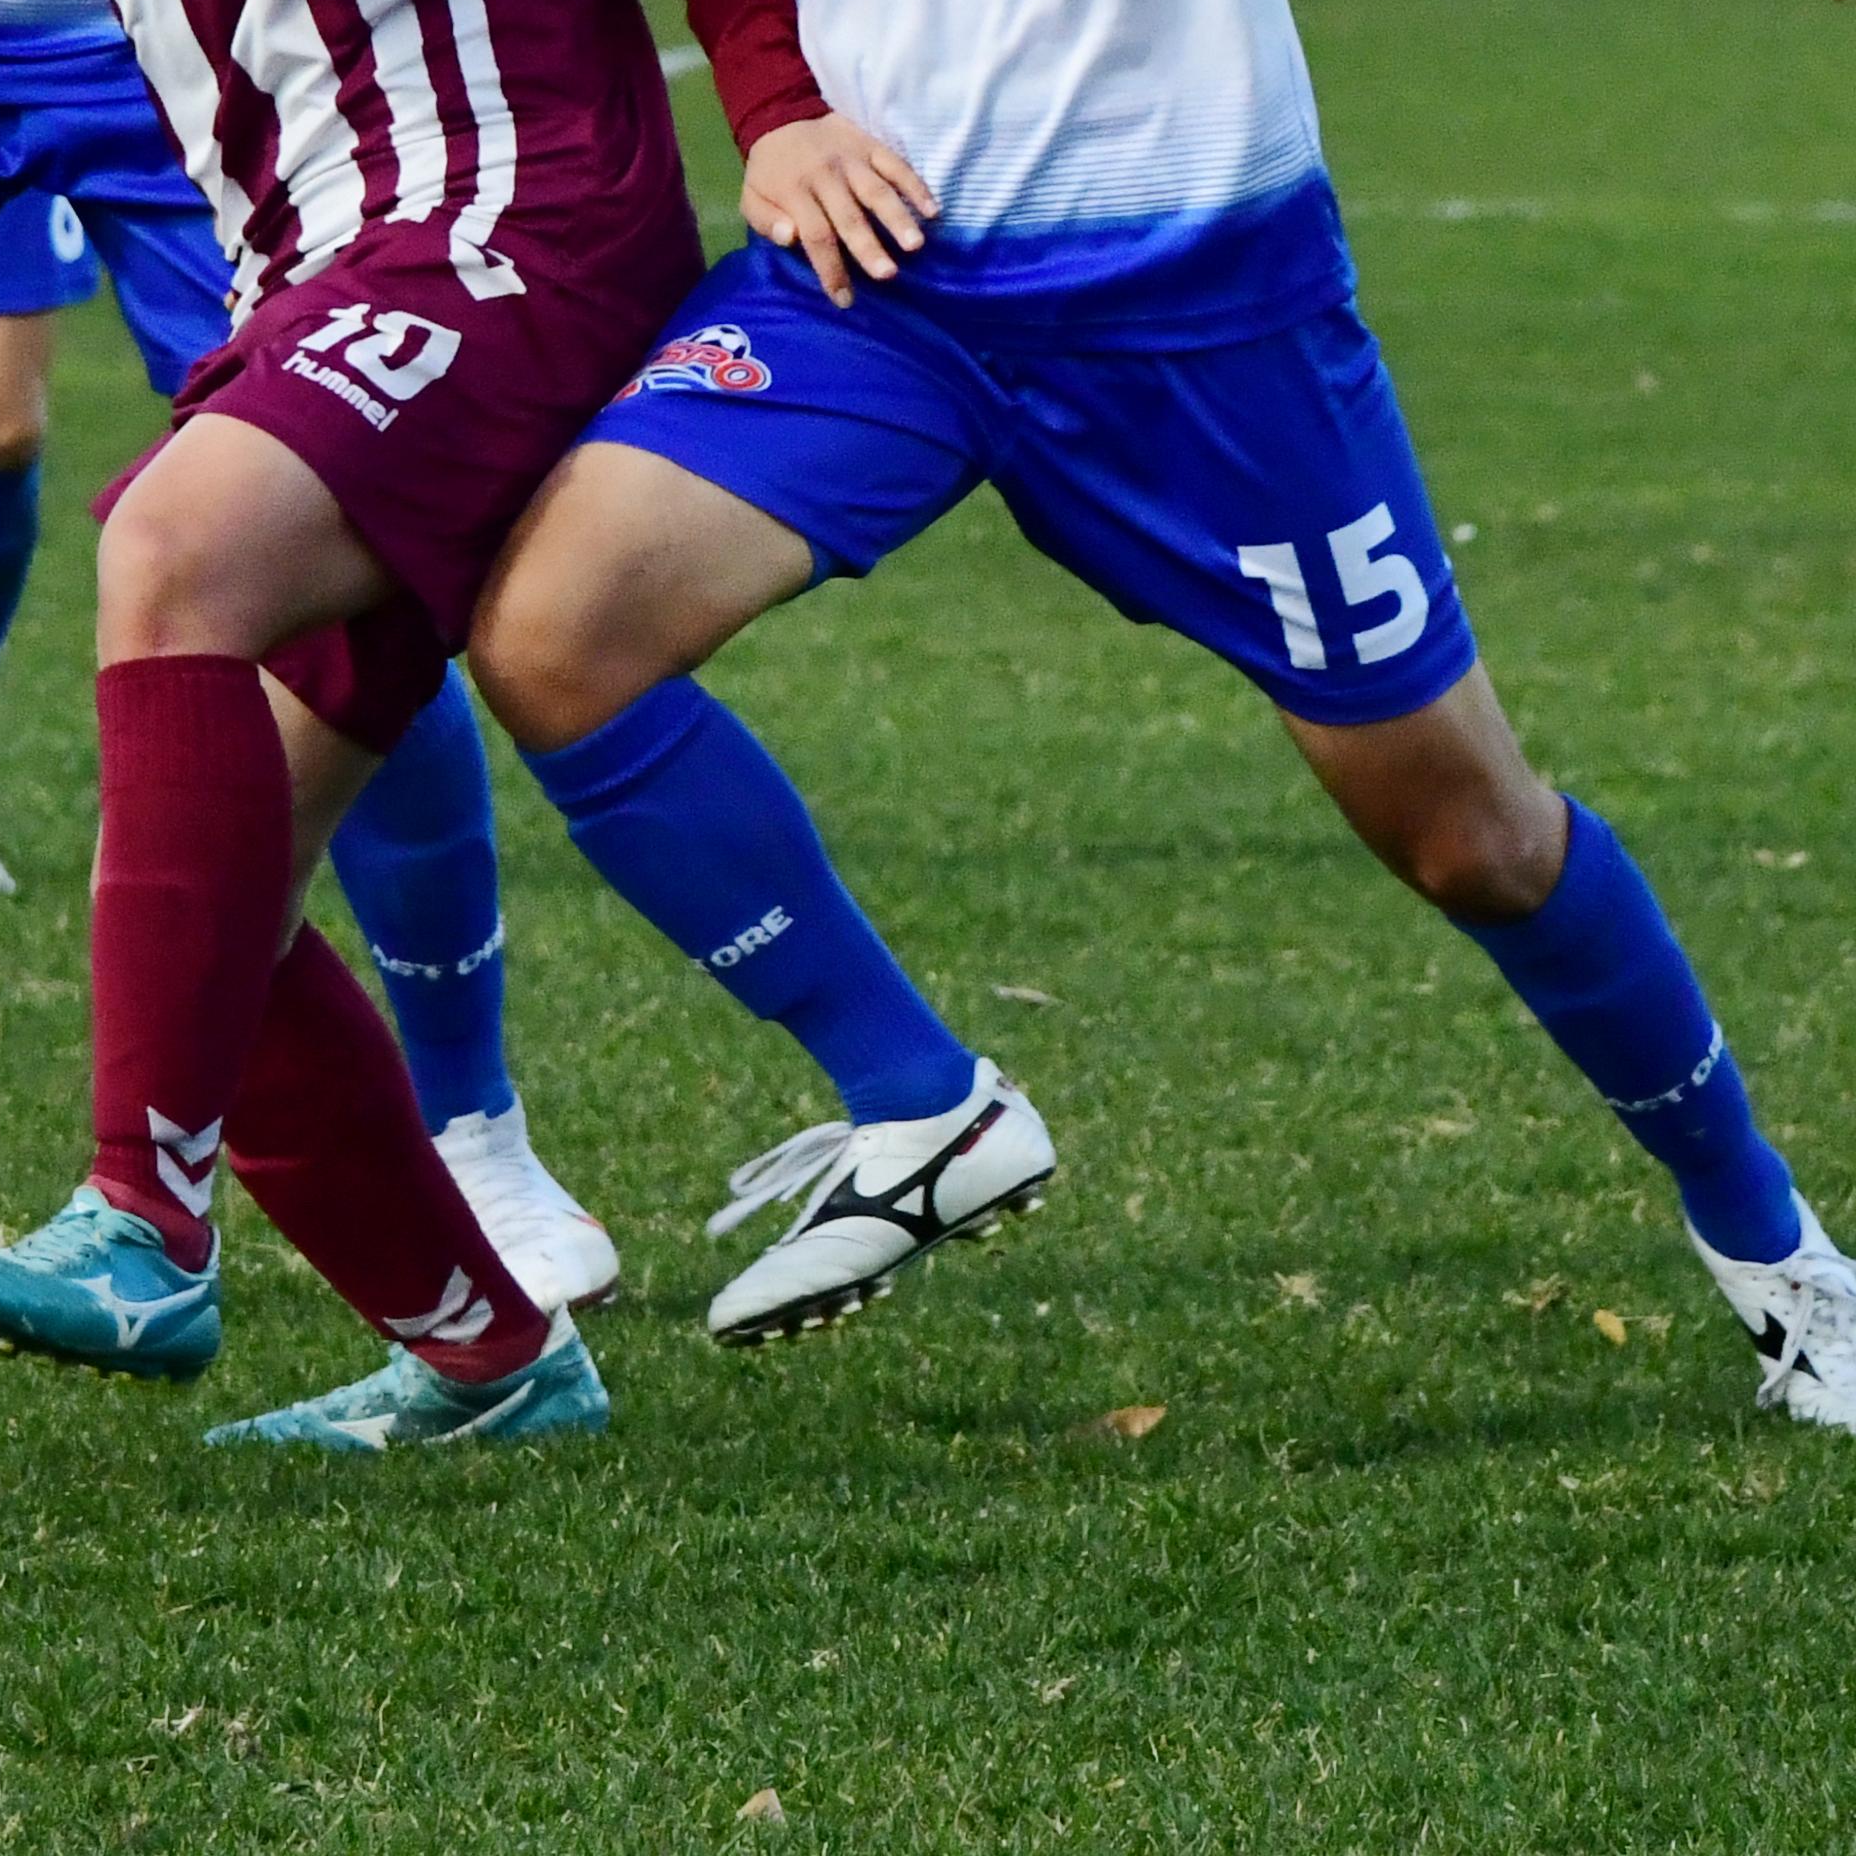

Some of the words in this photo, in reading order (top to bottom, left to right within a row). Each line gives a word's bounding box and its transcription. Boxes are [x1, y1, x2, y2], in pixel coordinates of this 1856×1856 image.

[280, 349, 400, 433] hummel
[296, 302, 463, 402] 10
[650, 340, 768, 392] SPO
[1236, 500, 1430, 671] 15
